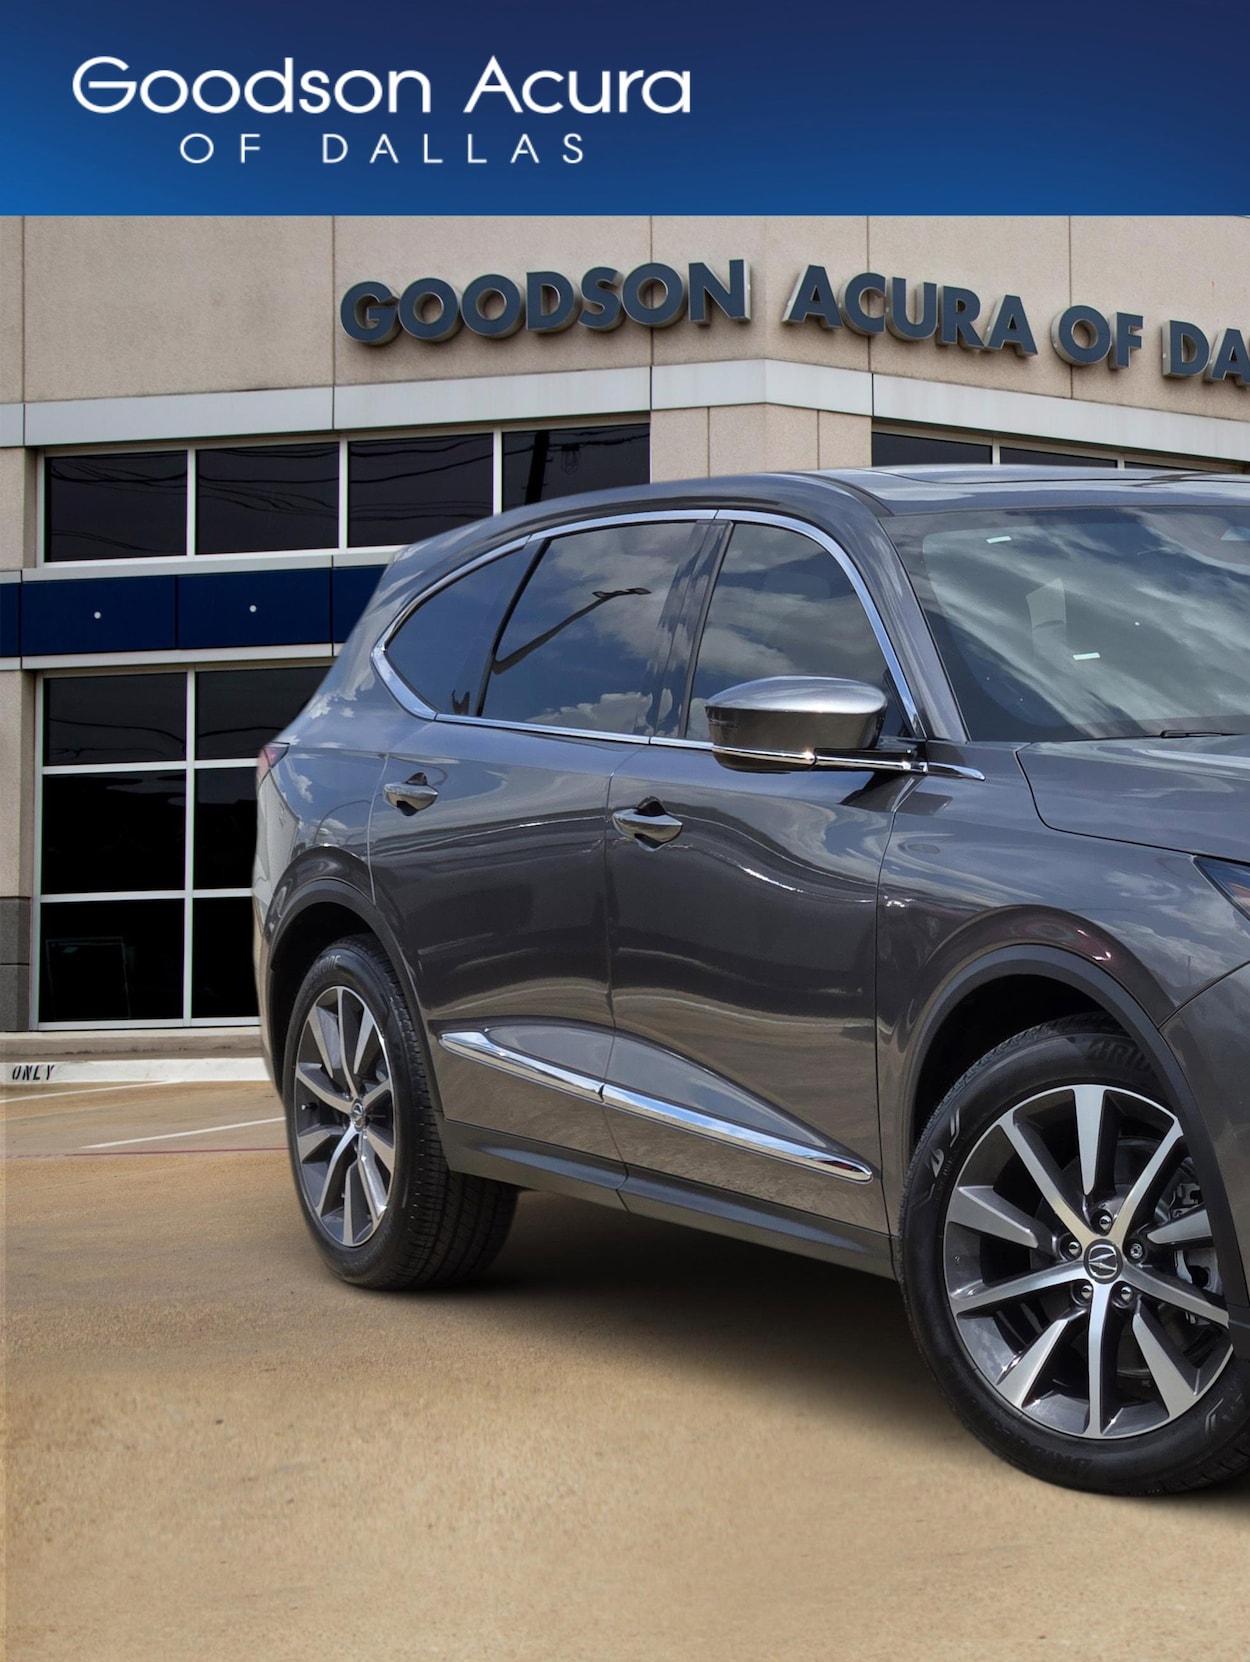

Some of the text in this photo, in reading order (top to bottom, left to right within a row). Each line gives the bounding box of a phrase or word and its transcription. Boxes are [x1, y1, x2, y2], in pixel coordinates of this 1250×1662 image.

[340, 258, 751, 347] GOODSON
[782, 264, 1038, 358] ACURA
[1050, 304, 1144, 369] OF
[11, 1064, 56, 1081] ONLY
